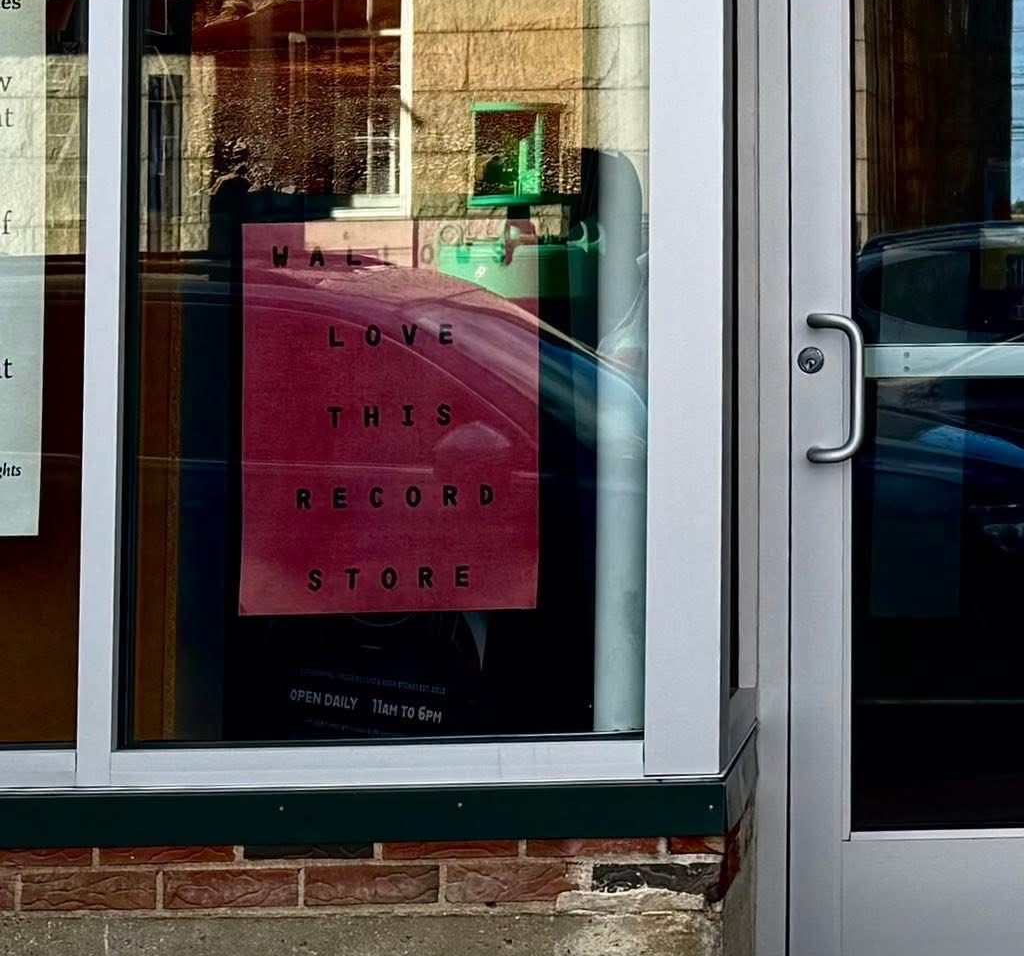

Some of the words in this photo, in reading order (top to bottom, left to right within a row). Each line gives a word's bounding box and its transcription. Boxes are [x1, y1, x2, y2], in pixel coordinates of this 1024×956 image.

[329, 324, 454, 346] LOVE
[327, 404, 452, 429] THIS
[296, 484, 495, 509] RECORD
[308, 565, 470, 592] STORE
[290, 689, 321, 705] OPEN
[324, 693, 358, 710] DAILY
[401, 705, 415, 719] TO
[417, 706, 443, 723] 6PM
